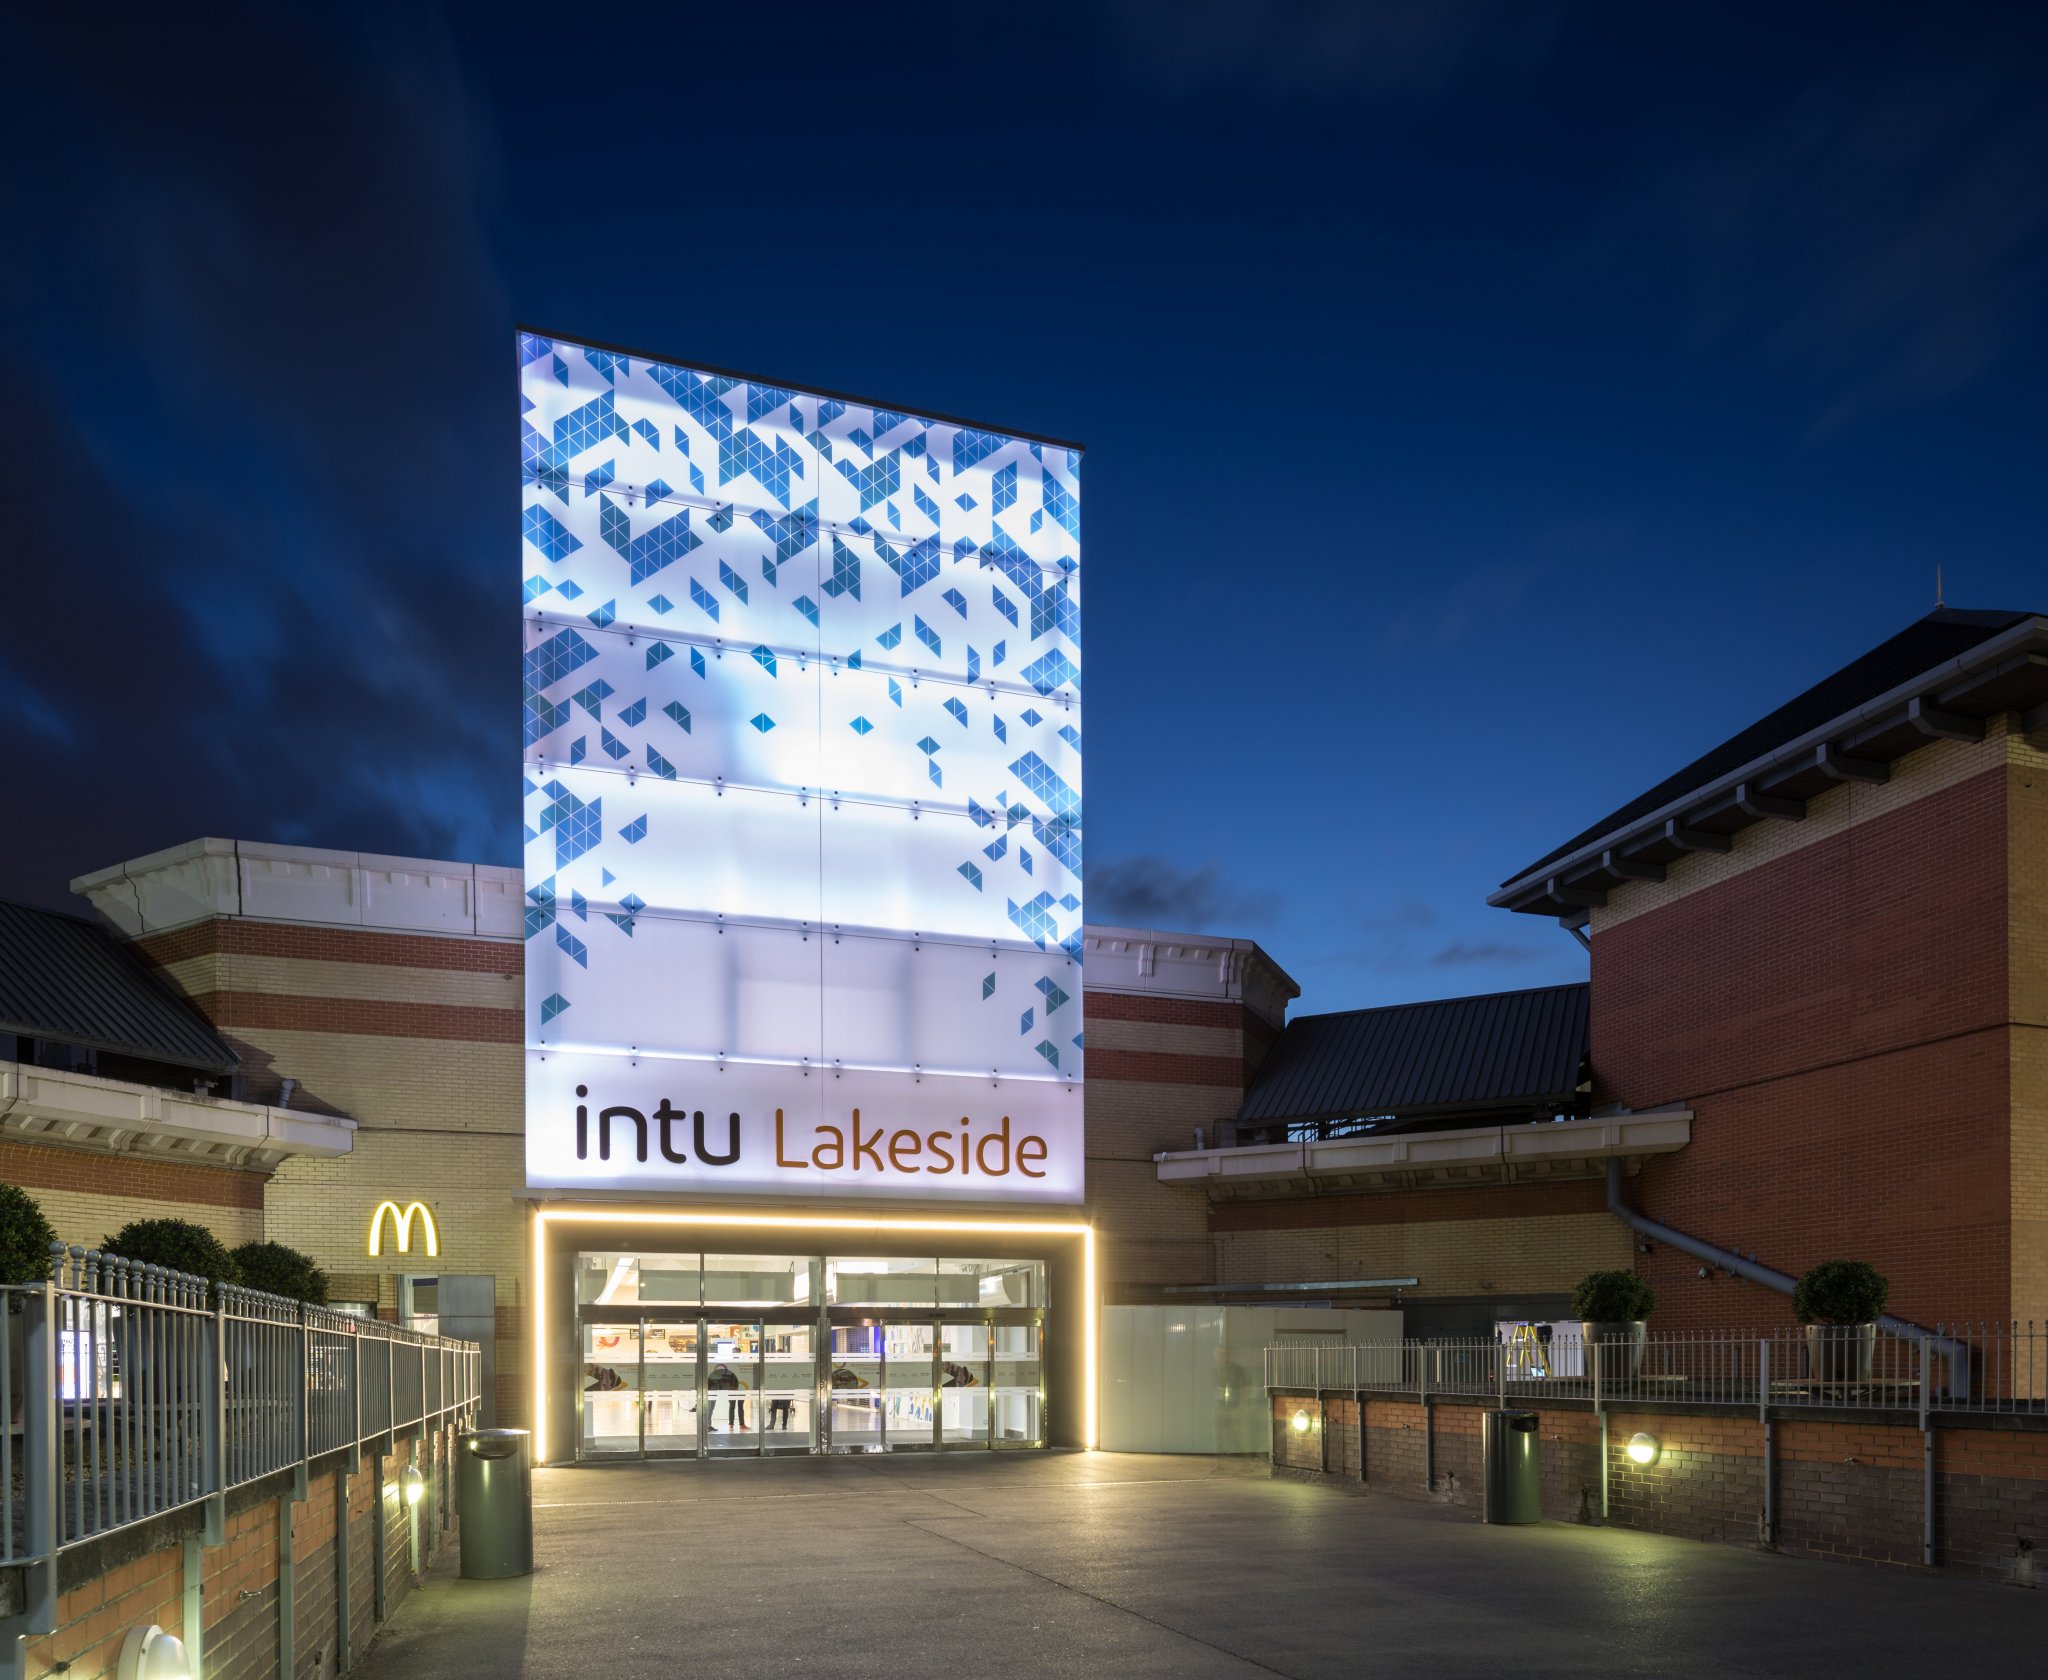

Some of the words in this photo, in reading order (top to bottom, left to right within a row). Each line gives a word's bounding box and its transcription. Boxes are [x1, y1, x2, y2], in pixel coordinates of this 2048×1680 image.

[575, 1084, 741, 1166] intu
[774, 1107, 1048, 1178] Lakeside
[368, 1200, 438, 1257] M
